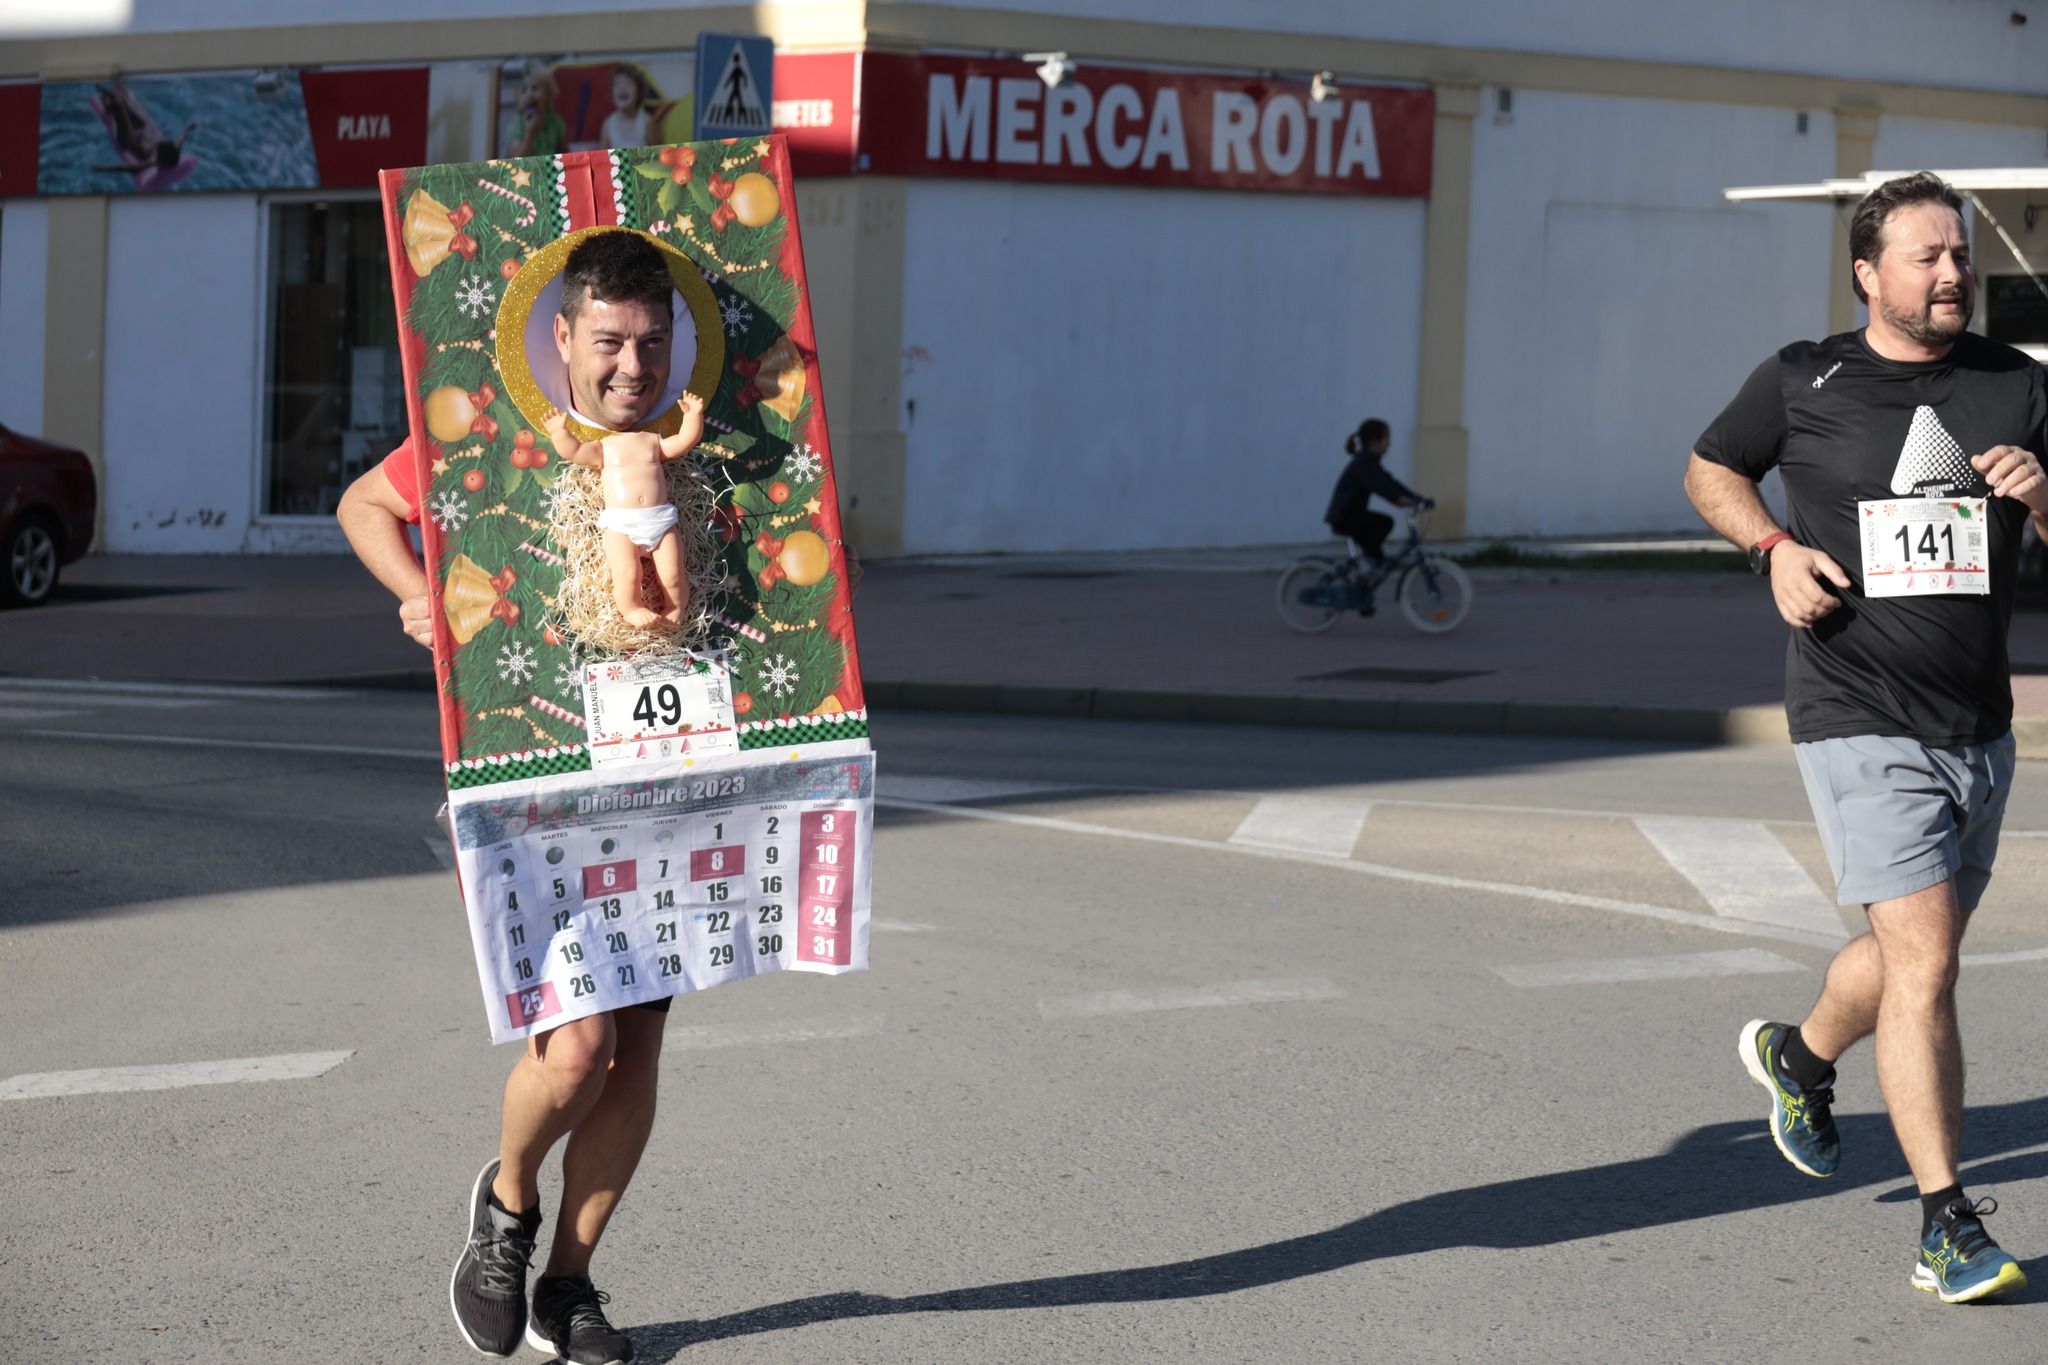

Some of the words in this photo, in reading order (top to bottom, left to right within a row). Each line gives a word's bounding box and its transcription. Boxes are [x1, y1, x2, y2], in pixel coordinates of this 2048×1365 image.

[338, 115, 391, 140] PLAYA
[925, 72, 1189, 172] MERCA
[1211, 91, 1380, 180] ROTA
[1914, 484, 1954, 494] ALZHEIMER
[1895, 524, 1954, 562] 141
[590, 682, 598, 714] MANUEL
[633, 684, 681, 727] 49
[578, 785, 688, 815] Diciembre
[692, 776, 745, 800] 2023
[541, 831, 568, 841] MARTES
[590, 823, 628, 833] MIÉRCOLES
[705, 810, 733, 818] VIERNES
[714, 823, 723, 840] 1
[767, 817, 779, 834] 2
[821, 814, 835, 833] 3
[508, 891, 518, 911] 4
[553, 878, 565, 898] 5
[603, 867, 616, 886] 6
[658, 859, 669, 878] 7
[711, 851, 724, 870] 8
[766, 846, 778, 864] 9
[816, 845, 838, 864] 10
[510, 924, 525, 946] 11
[552, 910, 573, 932] 12
[600, 898, 622, 920] 13
[654, 890, 675, 910] 14
[707, 882, 728, 902] 15
[760, 876, 782, 893] 16
[817, 875, 836, 895] 17
[515, 957, 534, 980] 18
[560, 942, 584, 964] 19
[606, 931, 628, 954] 20
[656, 921, 677, 943] 21
[707, 911, 730, 934] 22
[759, 904, 783, 923] 23
[813, 906, 836, 927] 24
[521, 990, 544, 1015] 25
[570, 974, 596, 998] 26
[618, 964, 635, 986] 27
[658, 954, 682, 978] 28
[710, 944, 734, 967] 29
[758, 935, 782, 955] 30
[813, 936, 835, 957] 31
